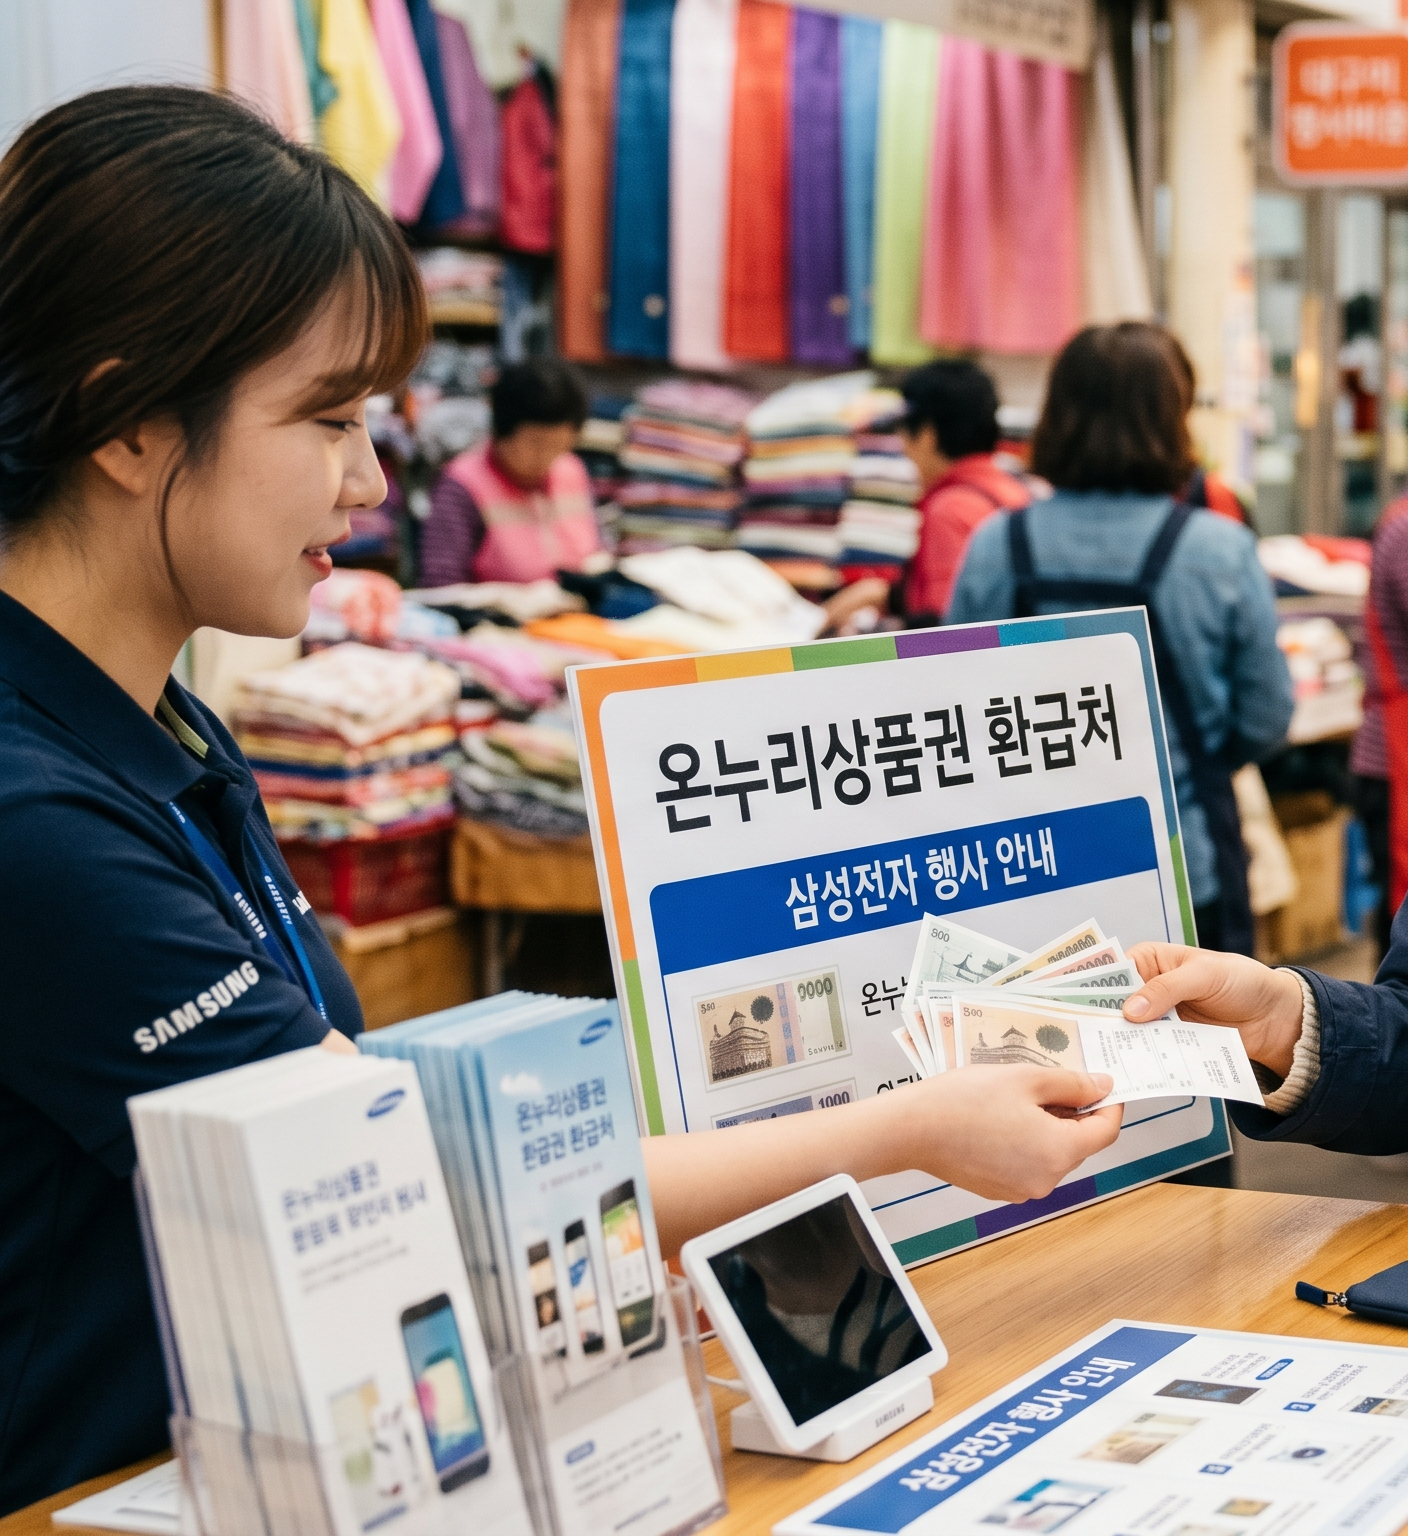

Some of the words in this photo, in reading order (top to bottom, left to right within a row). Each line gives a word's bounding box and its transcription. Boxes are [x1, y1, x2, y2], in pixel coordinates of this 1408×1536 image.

[655, 704, 974, 833] 온누리상품권
[984, 684, 1123, 778] 환급처
[785, 854, 918, 930] 삼성전자
[925, 840, 988, 901] 행사
[995, 827, 1058, 886] 안내
[133, 960, 260, 1053] SAMSUNG
[861, 976, 908, 1017] 온누
[899, 1421, 1037, 1492] 삼성전자
[1005, 1386, 1088, 1422] 행사
[1059, 1356, 1137, 1388] 안내
